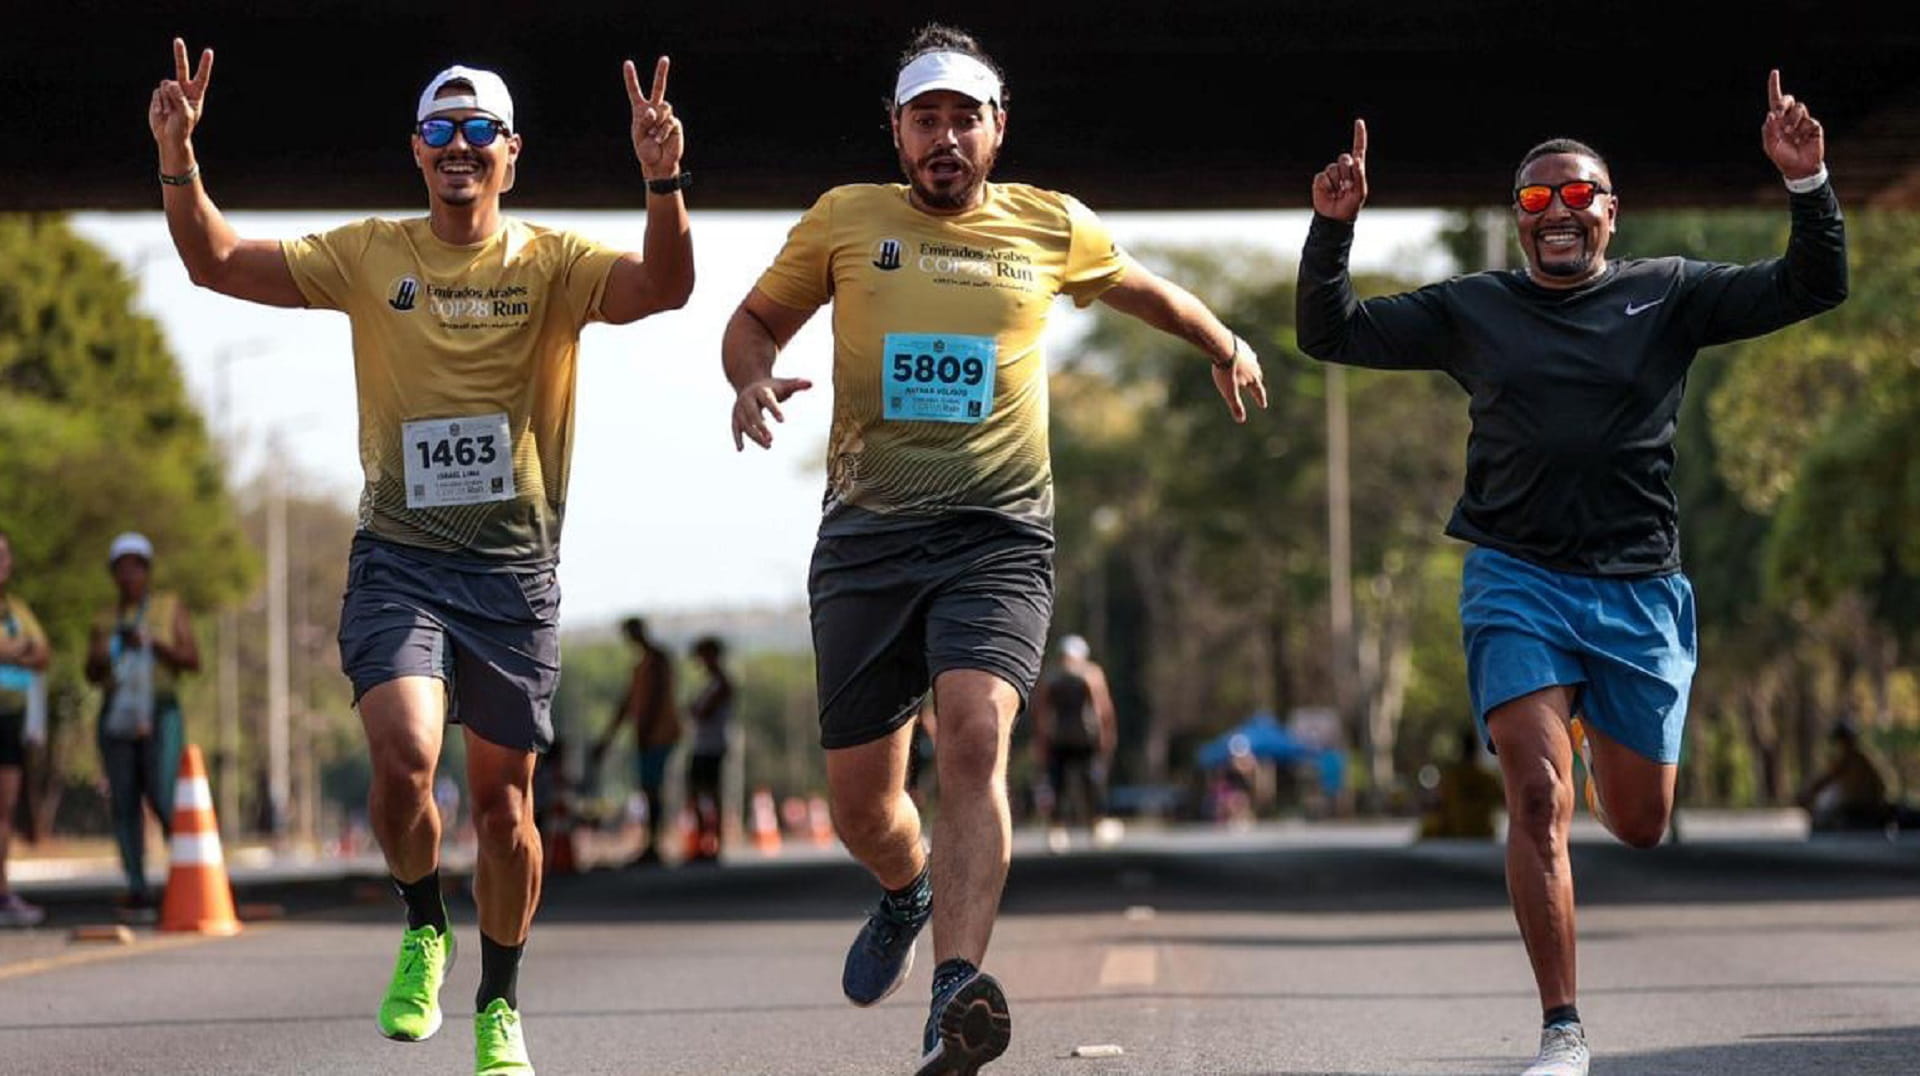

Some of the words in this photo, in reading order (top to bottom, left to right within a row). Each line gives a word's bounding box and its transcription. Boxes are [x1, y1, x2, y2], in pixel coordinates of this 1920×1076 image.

[920, 243, 984, 259] Emirados
[996, 261, 1032, 281] Run
[426, 284, 482, 298] Emirados
[493, 300, 528, 316] Run
[893, 354, 983, 385] 5809
[416, 435, 496, 469] 1463
